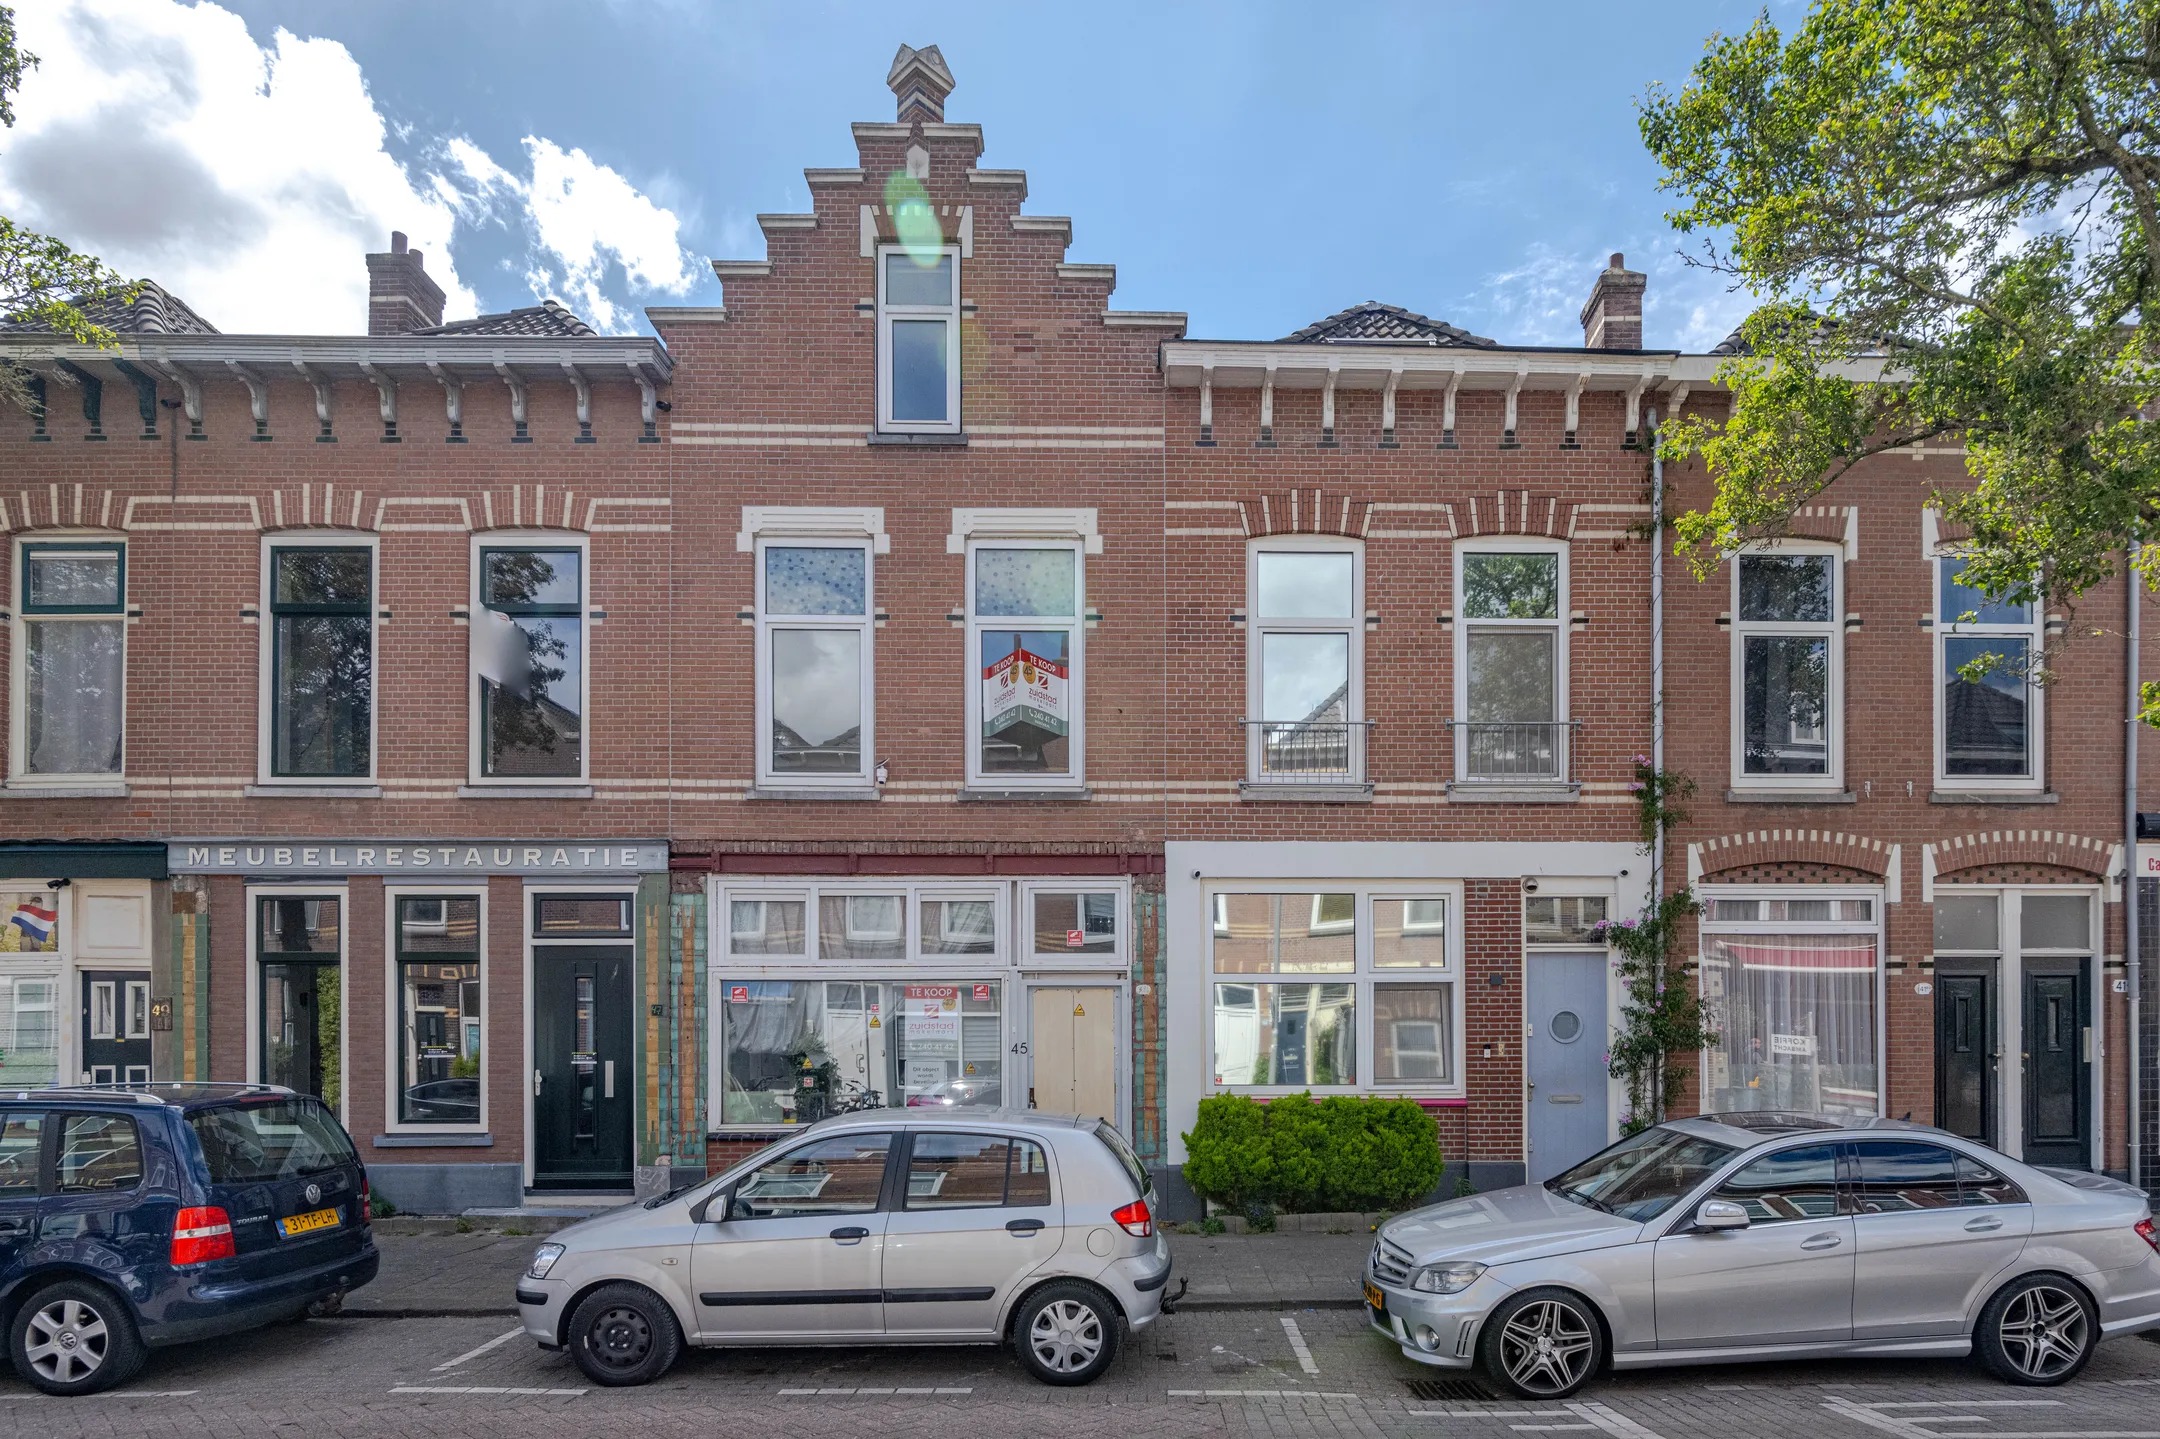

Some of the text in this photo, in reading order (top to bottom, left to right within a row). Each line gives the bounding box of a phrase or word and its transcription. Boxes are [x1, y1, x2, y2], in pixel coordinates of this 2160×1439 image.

[993, 655, 1015, 673] TE KOOP
[1023, 666, 1033, 676] 45
[1030, 656, 1056, 673] TE KOOP
[994, 686, 1016, 705] zuidstad
[1029, 687, 1057, 705] zuidstad
[1034, 710, 1044, 720] 240
[1051, 718, 1058, 726] 42
[188, 847, 639, 866] MEUBELRESTAURATIE
[911, 988, 952, 997] TE KOOP
[152, 1004, 170, 1016] 49
[909, 1021, 954, 1030] zuidstad
[1011, 1042, 1028, 1054] 45
[236, 1214, 269, 1226] TOURAN
[288, 1211, 335, 1231] 31-TF-LH
